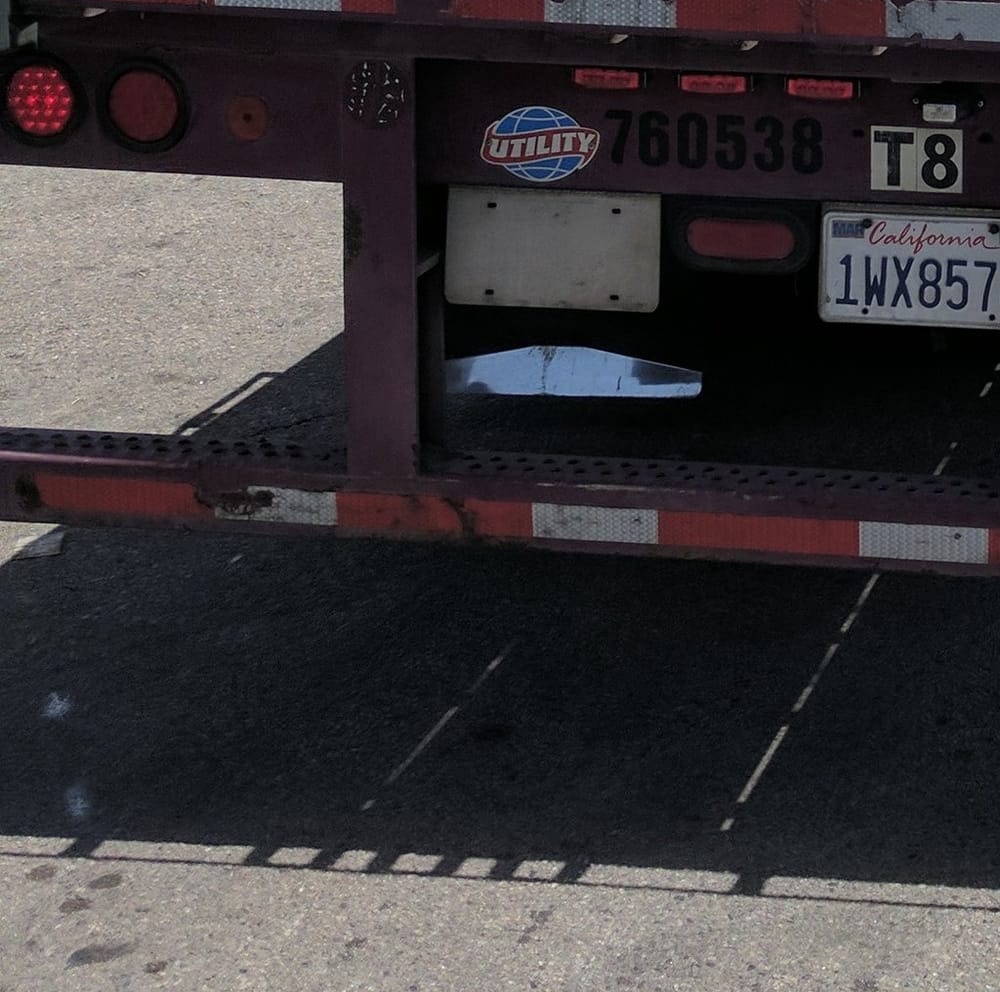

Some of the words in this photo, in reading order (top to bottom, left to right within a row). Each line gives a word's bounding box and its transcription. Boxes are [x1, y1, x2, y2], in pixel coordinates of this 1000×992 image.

[488, 132, 596, 159] UTILITY
[605, 110, 825, 175] 760538
[873, 130, 959, 189] T8
[868, 220, 1000, 255] California
